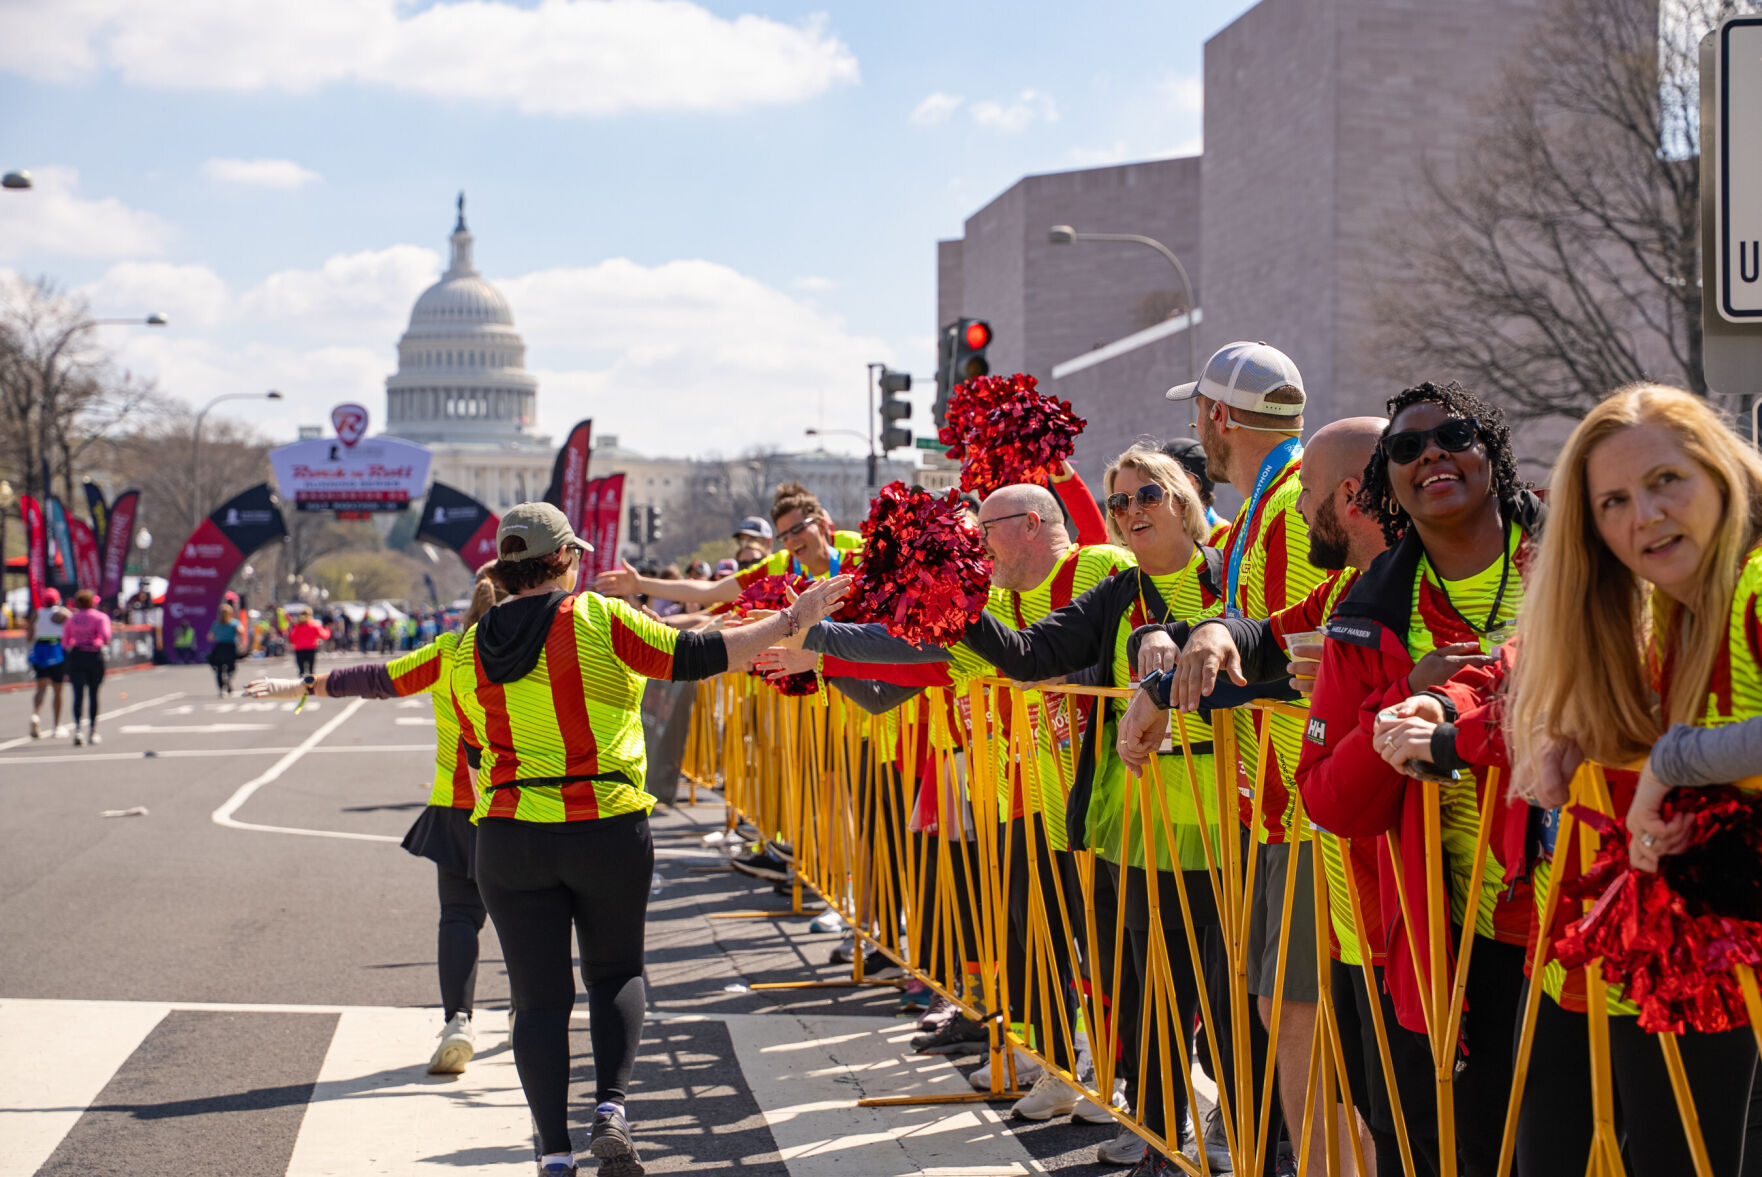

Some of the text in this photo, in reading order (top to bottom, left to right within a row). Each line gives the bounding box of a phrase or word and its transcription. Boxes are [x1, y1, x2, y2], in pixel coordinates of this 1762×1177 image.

[1249, 464, 1273, 512] MARATHON
[1347, 628, 1371, 638] HANSEN
[1307, 719, 1326, 739] HH
